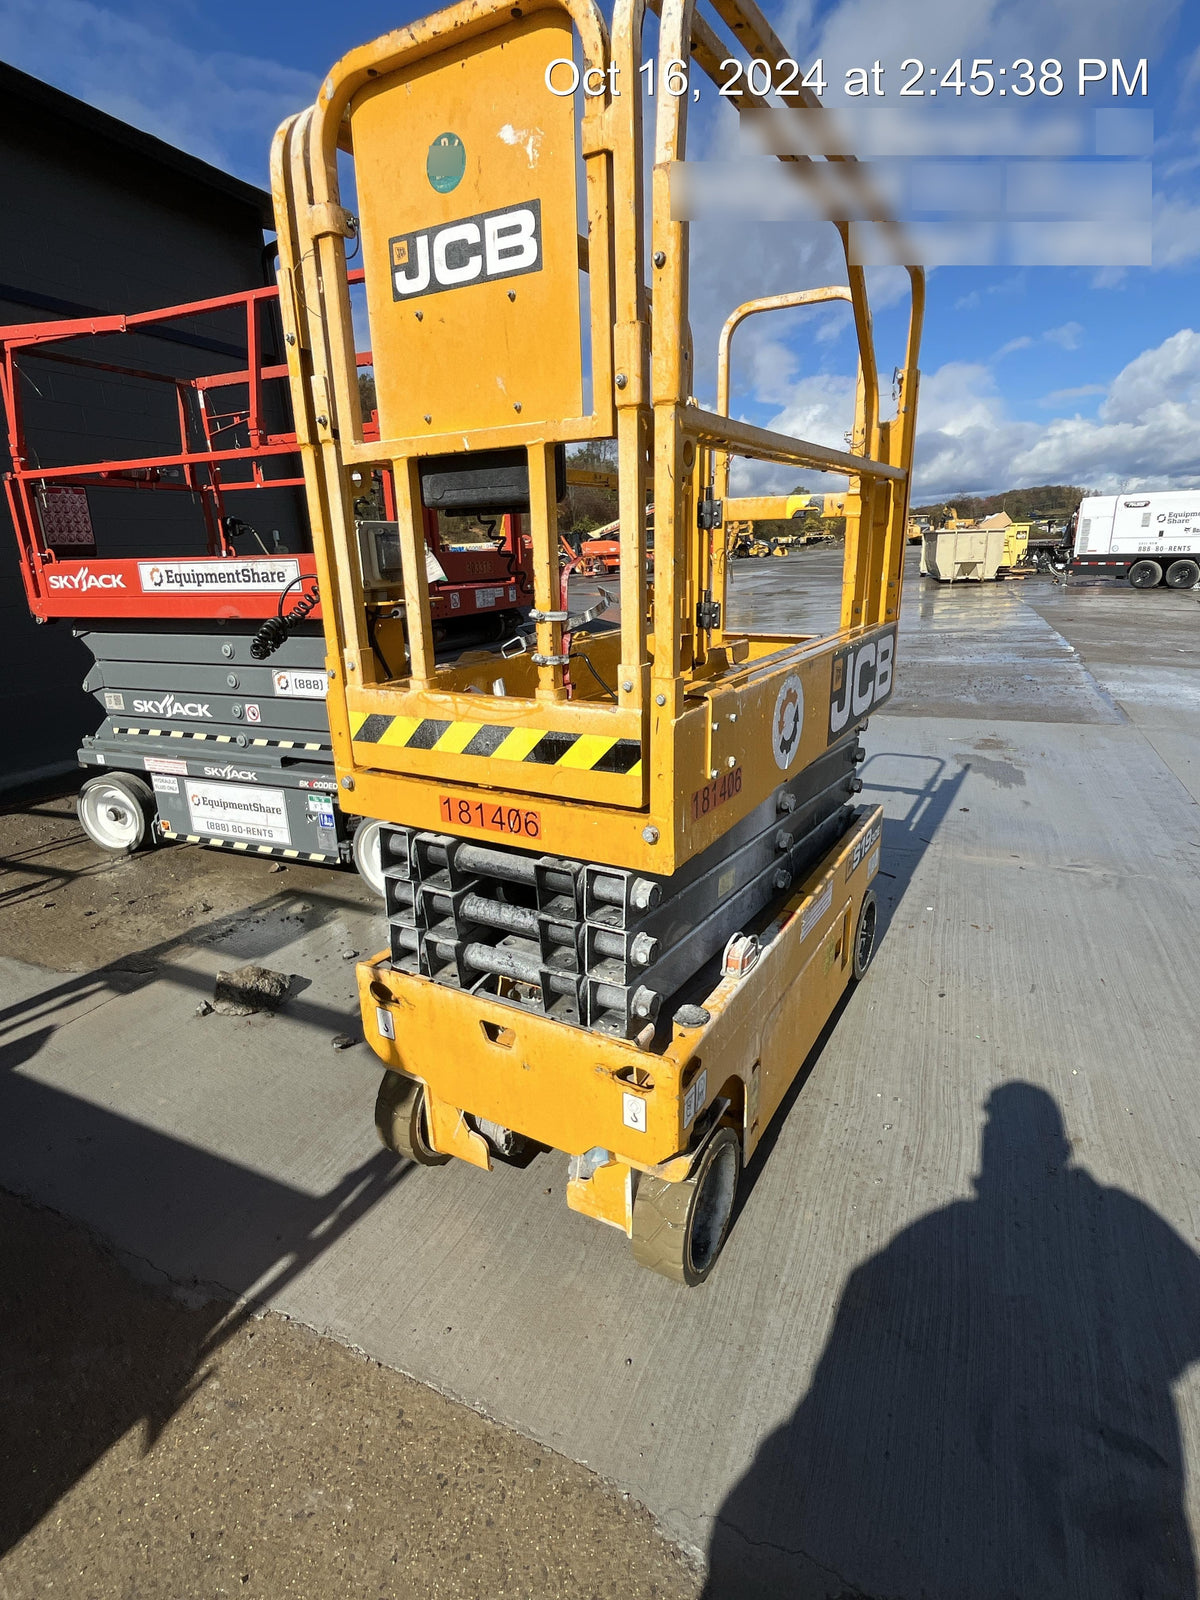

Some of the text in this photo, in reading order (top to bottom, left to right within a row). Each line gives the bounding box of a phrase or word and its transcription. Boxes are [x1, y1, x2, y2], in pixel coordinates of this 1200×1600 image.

[394, 208, 538, 295] JCB
[48, 567, 127, 592] SKYJACK
[165, 568, 287, 588] EquipmentShare
[294, 678, 324, 691] (888)
[830, 634, 894, 733] JCB
[133, 694, 213, 718] SKYJACK
[203, 765, 258, 781] SKYJACK
[693, 767, 742, 819] 181406
[201, 796, 283, 815] EquipmentShare
[443, 797, 539, 837] 181406
[206, 820, 274, 839] (888) 80-RENTS
